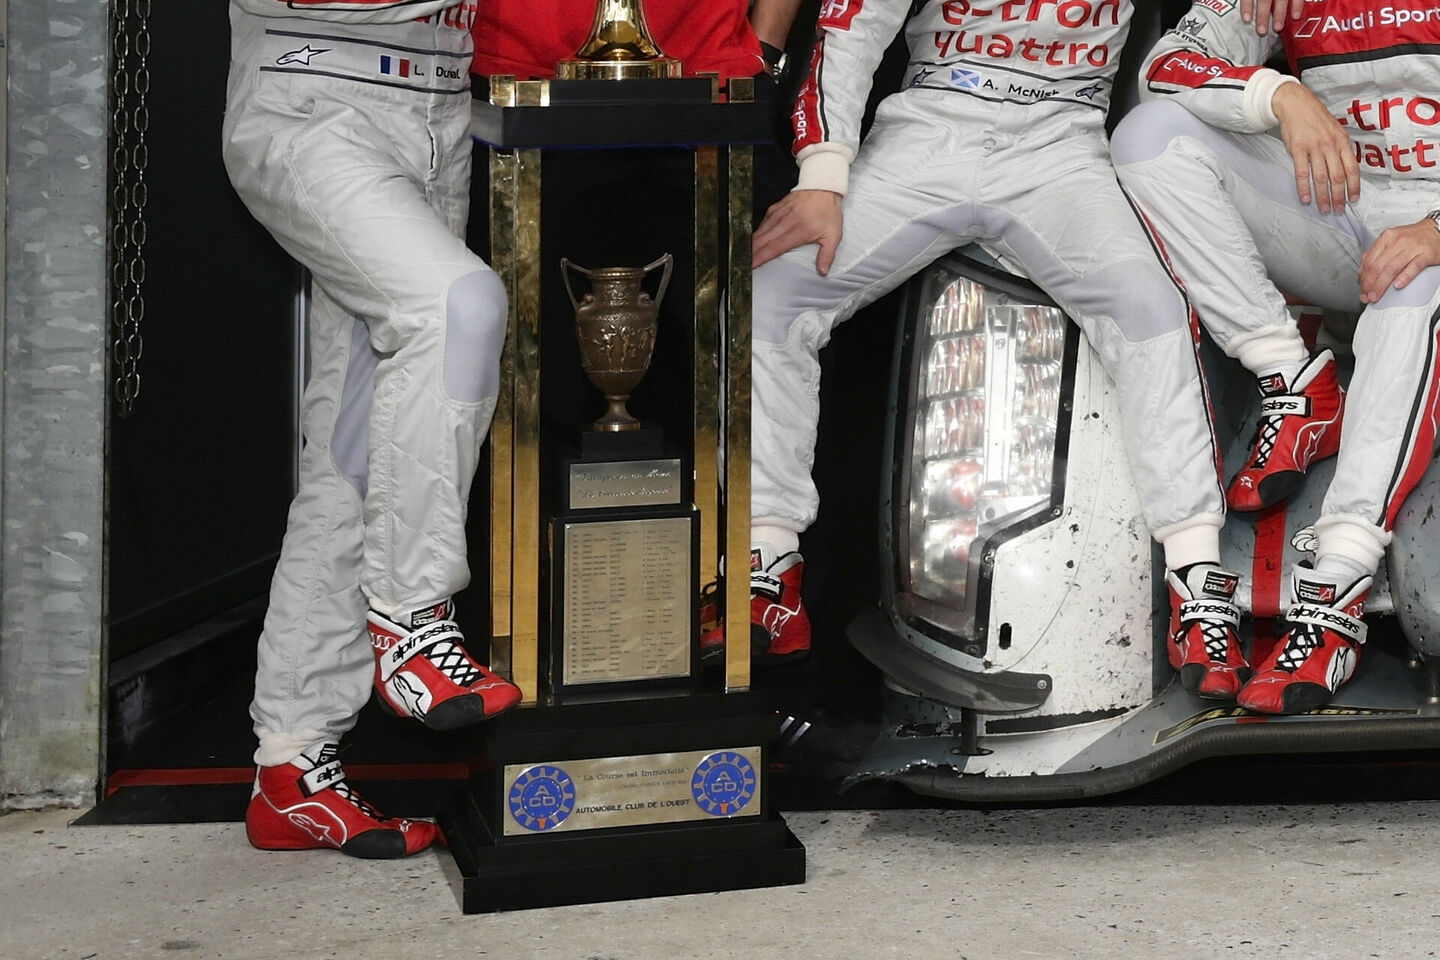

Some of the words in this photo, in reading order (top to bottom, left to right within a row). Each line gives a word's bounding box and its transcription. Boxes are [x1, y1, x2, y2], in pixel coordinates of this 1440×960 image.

[1321, 11, 1374, 33] Audi
[934, 30, 1109, 68] quattro
[414, 64, 425, 77] L.
[982, 78, 999, 91] A.
[576, 804, 622, 814] AUTOMOBILE
[625, 801, 645, 810] CLUB
[647, 800, 658, 808] DE
